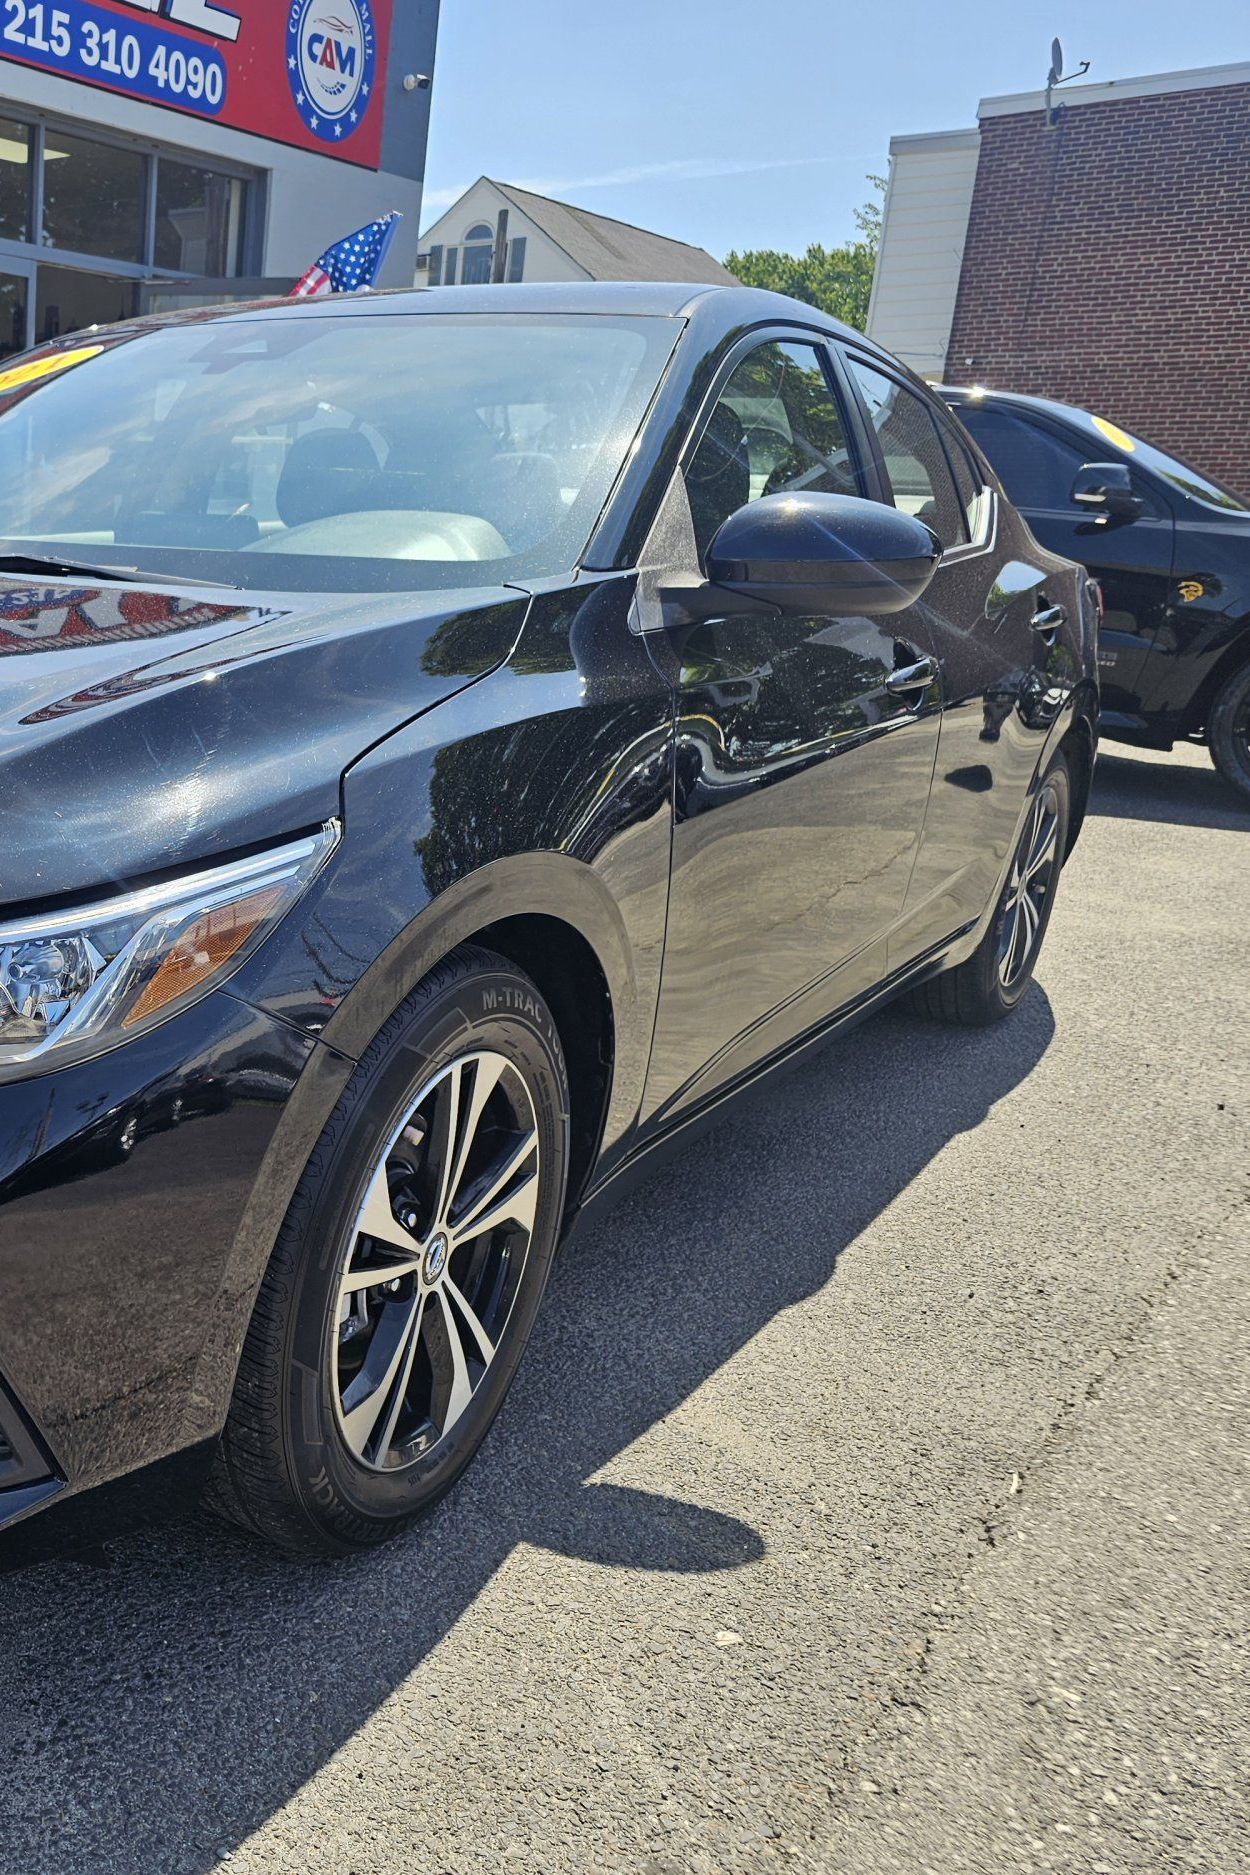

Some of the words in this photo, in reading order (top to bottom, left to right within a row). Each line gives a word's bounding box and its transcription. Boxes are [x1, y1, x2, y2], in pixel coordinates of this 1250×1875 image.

[3, 0, 71, 57] 215
[79, 20, 141, 79] 310
[148, 45, 223, 105] 4090
[307, 32, 356, 78] CAM
[359, 2, 374, 60] MALL
[481, 986, 543, 1024] M-TRAC
